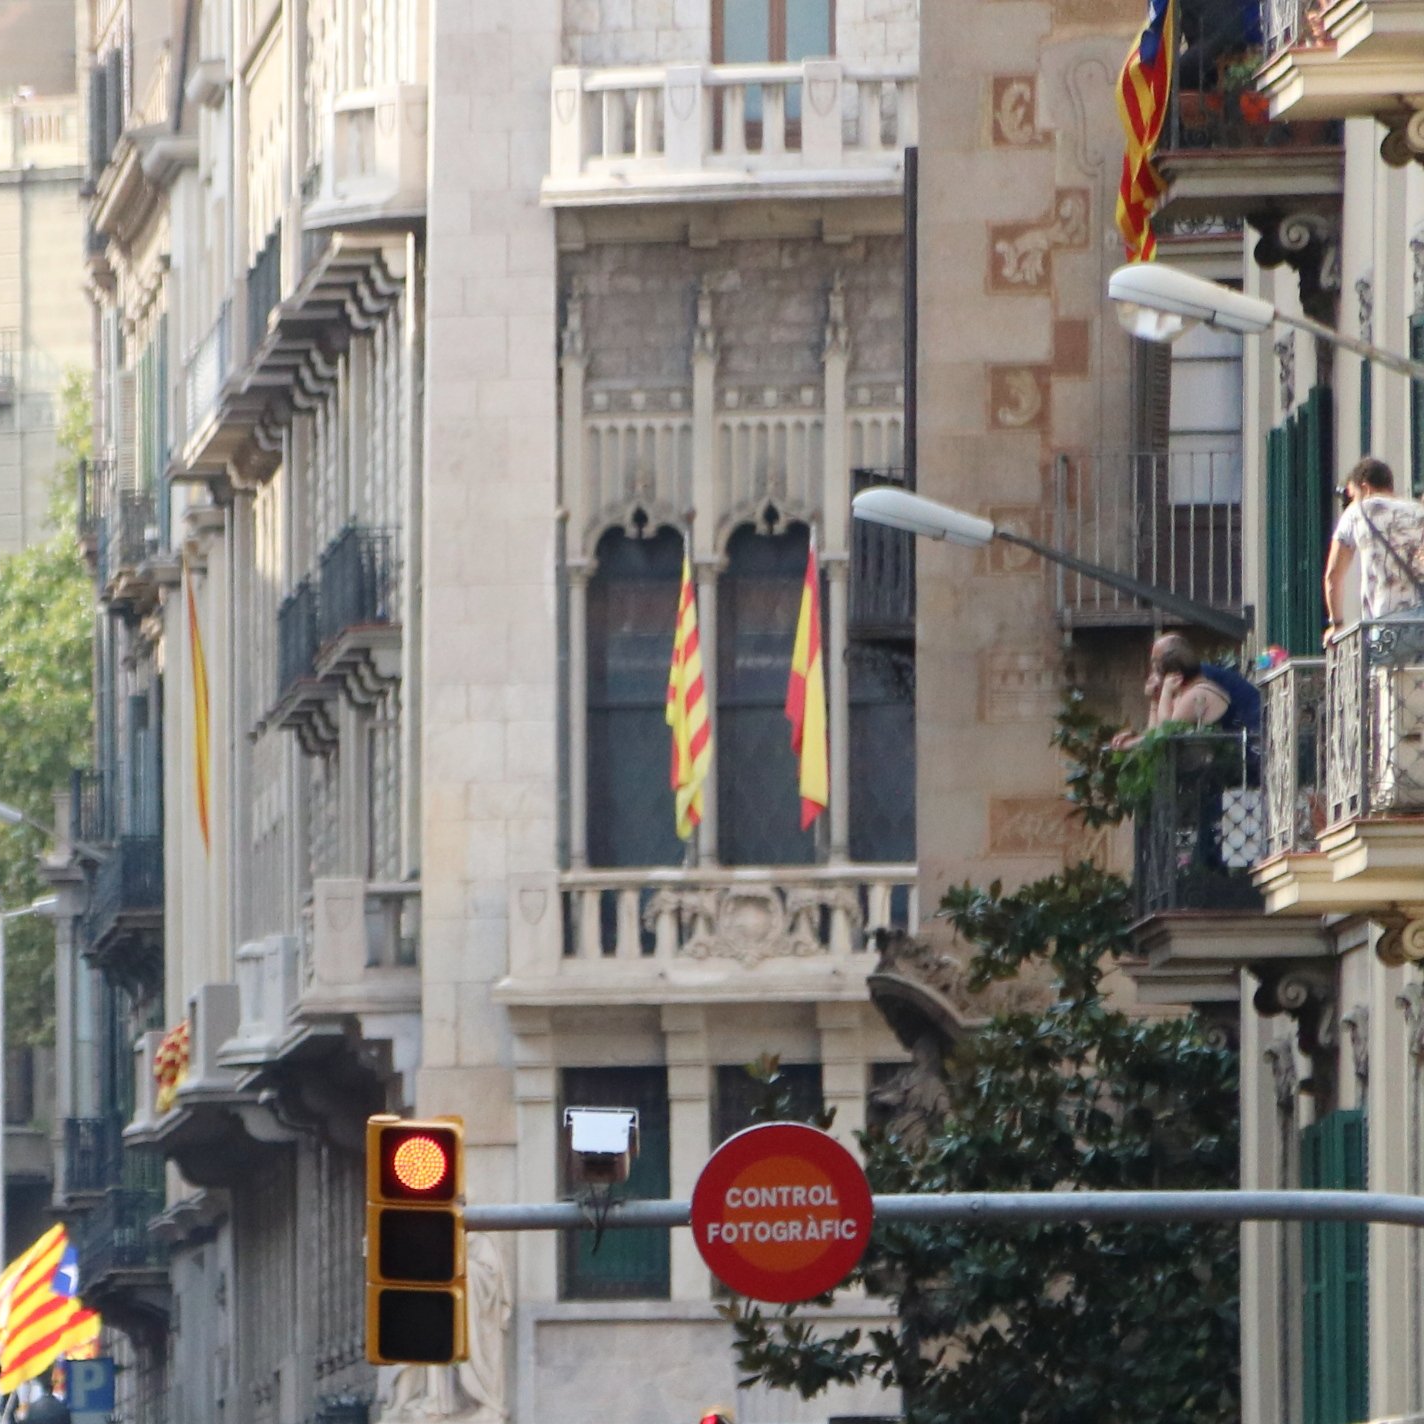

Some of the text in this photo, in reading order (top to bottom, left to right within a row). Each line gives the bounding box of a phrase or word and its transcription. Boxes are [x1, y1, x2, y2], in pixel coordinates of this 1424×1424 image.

[725, 1185, 838, 1209] CONTROL
[707, 1215, 857, 1244] FOTOGRÀFIC
[74, 1367, 107, 1409] P
